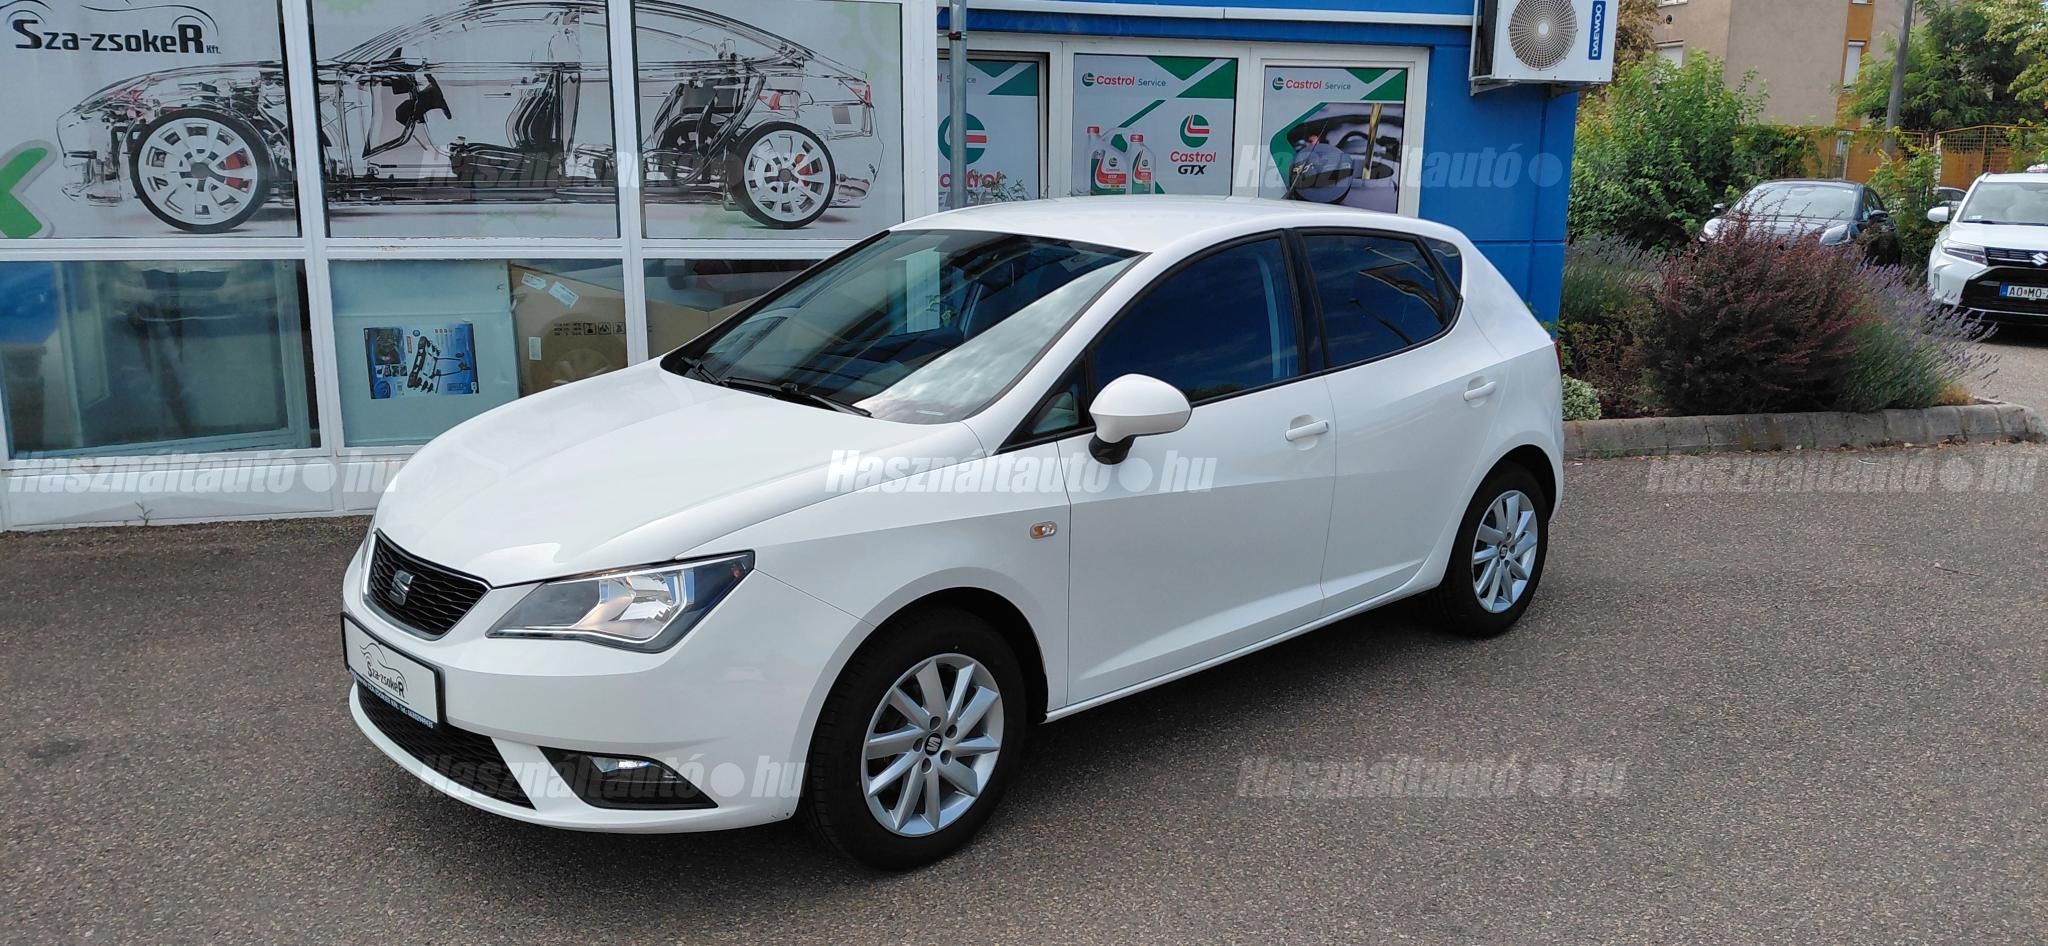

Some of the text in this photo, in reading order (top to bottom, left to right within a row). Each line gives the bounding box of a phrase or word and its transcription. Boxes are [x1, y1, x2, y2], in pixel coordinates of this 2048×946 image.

[12, 19, 222, 54] Sza-zsokeR Kft.
[1592, 4, 1603, 57] DAEWOO
[1096, 75, 1166, 87] Castrol Service
[1285, 79, 1351, 90] Castrol Service
[1170, 151, 1217, 163] Castrol
[1178, 165, 1207, 176] GTX
